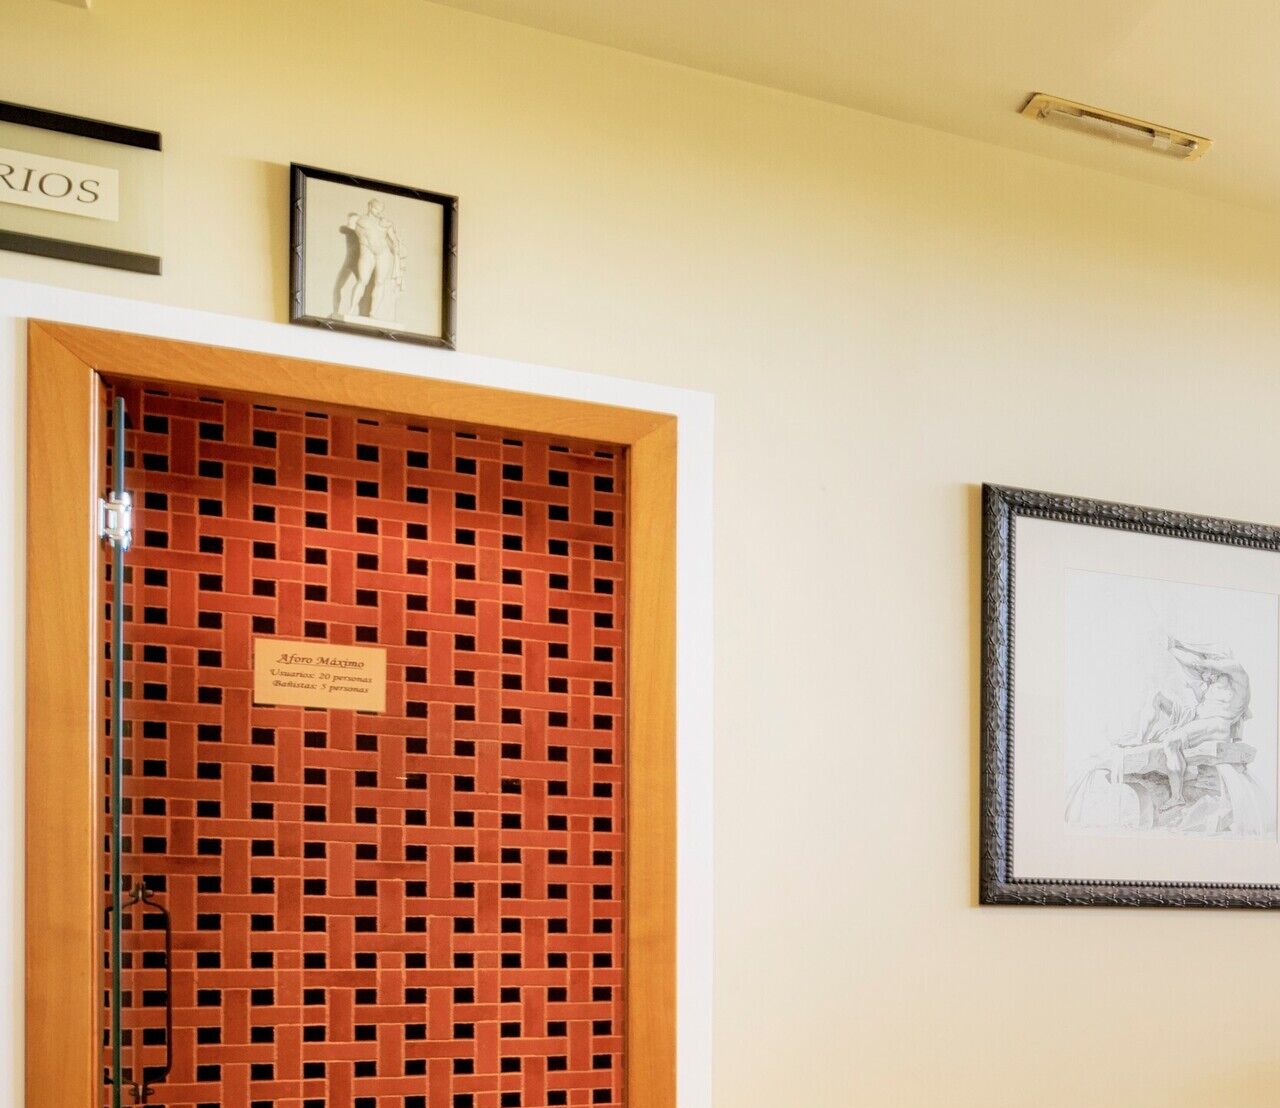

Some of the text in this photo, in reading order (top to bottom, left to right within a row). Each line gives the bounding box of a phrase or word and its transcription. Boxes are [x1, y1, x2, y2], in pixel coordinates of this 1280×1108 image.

[276, 653, 365, 668] Aforo Máximo
[332, 674, 373, 684] personas
[329, 684, 369, 694] personas
